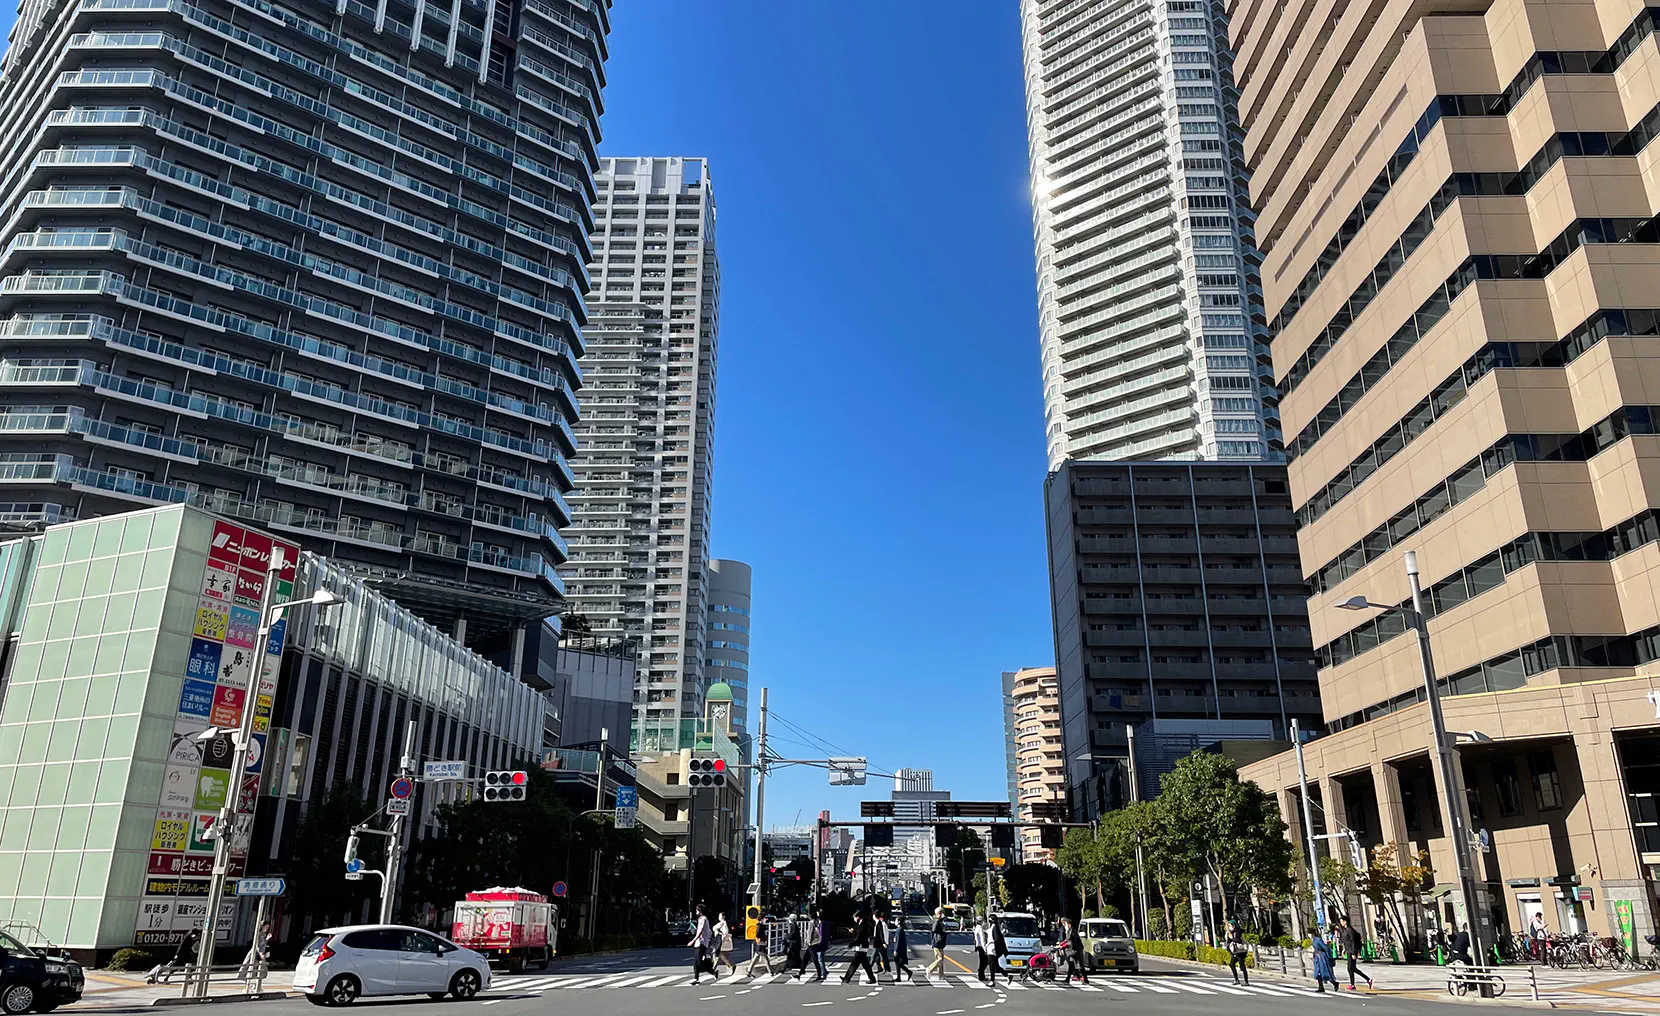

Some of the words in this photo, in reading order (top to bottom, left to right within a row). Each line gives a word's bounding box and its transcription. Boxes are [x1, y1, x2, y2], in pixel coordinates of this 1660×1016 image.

[226, 541, 296, 570] ニッポンレカー
[202, 610, 223, 621] ロイヤル
[198, 619, 225, 631] ハウジング
[189, 657, 216, 677] 眼科
[175, 751, 200, 761] PIRICA
[426, 763, 462, 772] 勝どき駅前
[161, 821, 184, 831] ロイヤル
[155, 831, 186, 840] ハウジング
[171, 858, 243, 872] 勝どきビュワー
[144, 903, 169, 914] 駅徒歩
[147, 914, 163, 928] 1分
